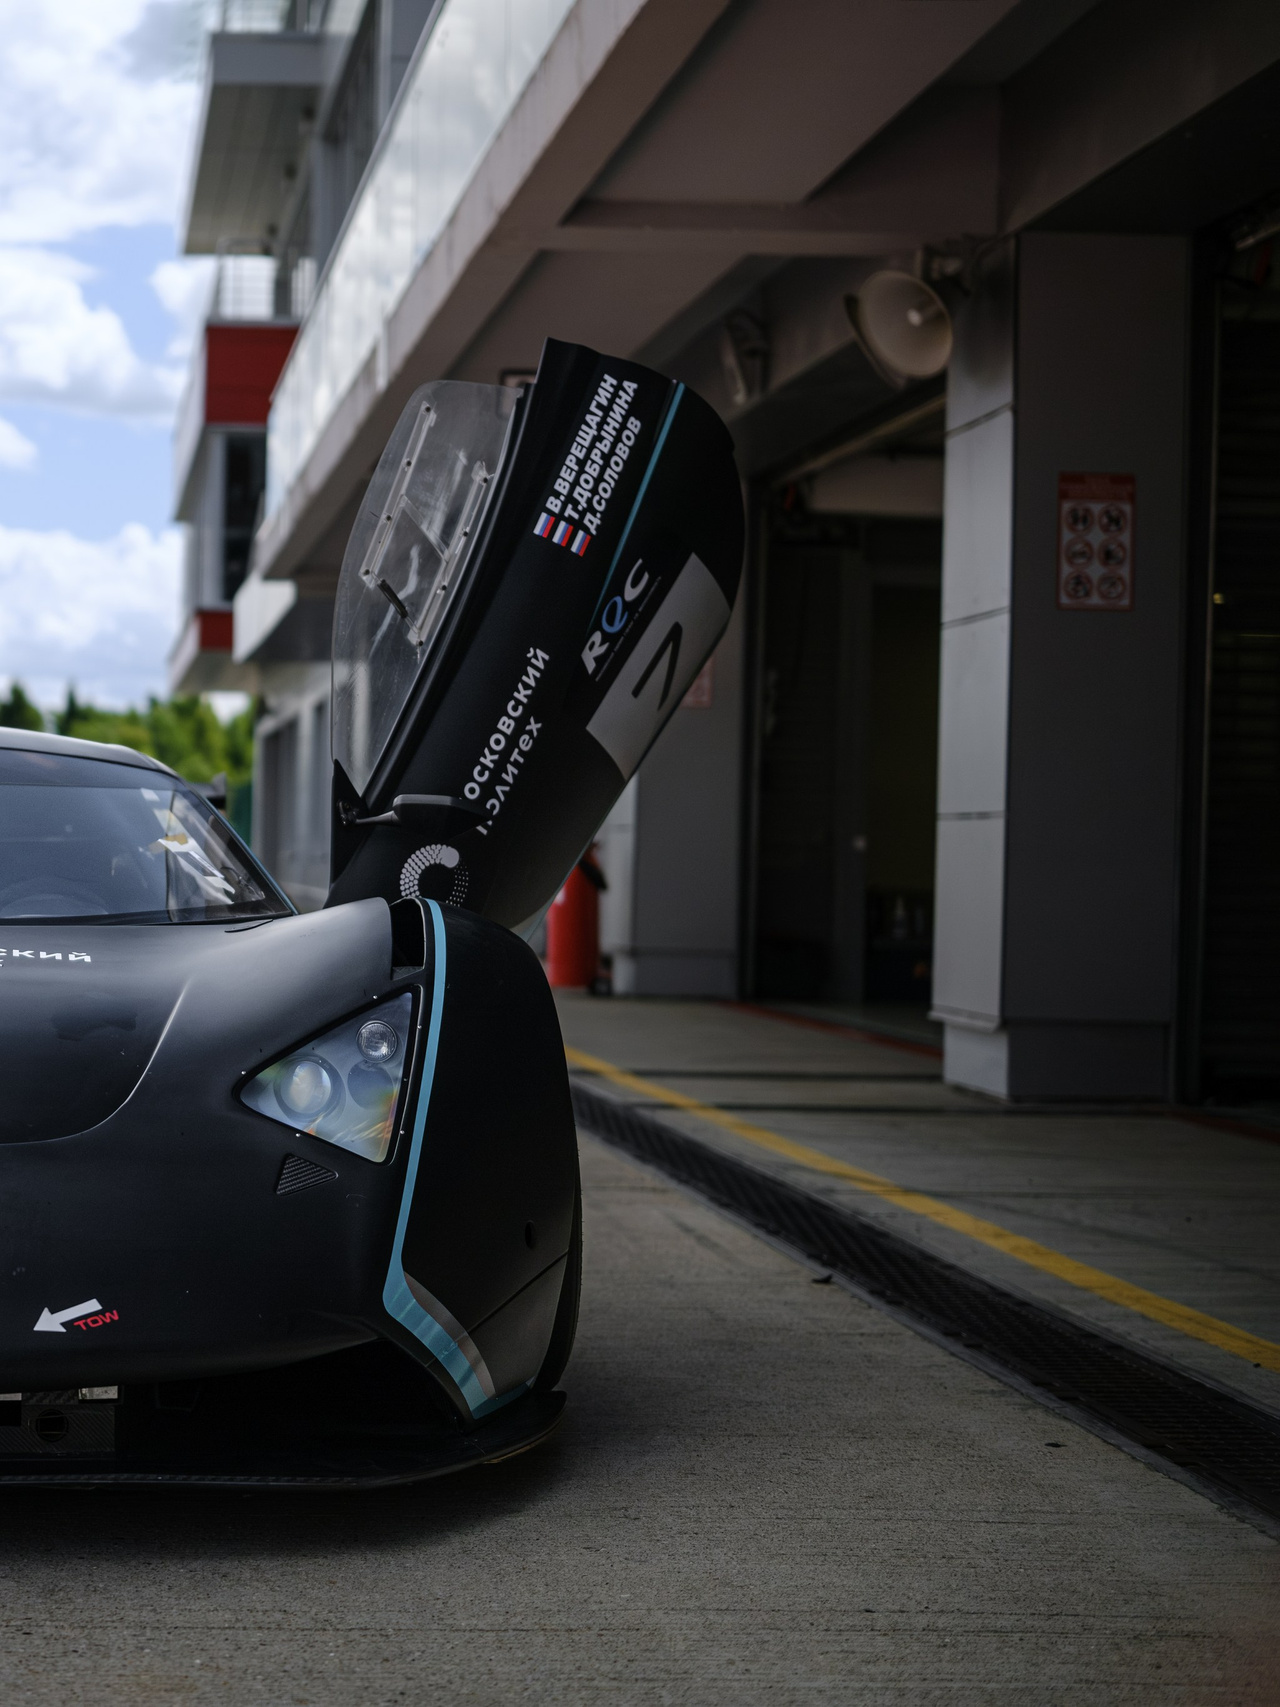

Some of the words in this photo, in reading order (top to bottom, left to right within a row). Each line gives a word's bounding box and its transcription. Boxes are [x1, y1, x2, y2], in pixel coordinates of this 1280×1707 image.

[545, 373, 618, 514] В.ВЕРЕЩАГИН
[563, 380, 639, 521] Т.ДОБРЫНИНА
[582, 416, 642, 536] Д.СОЛОВОВ
[463, 647, 550, 800] ОСКОВСКИЙ
[631, 621, 683, 712] 7
[73, 1309, 119, 1331] TOW
